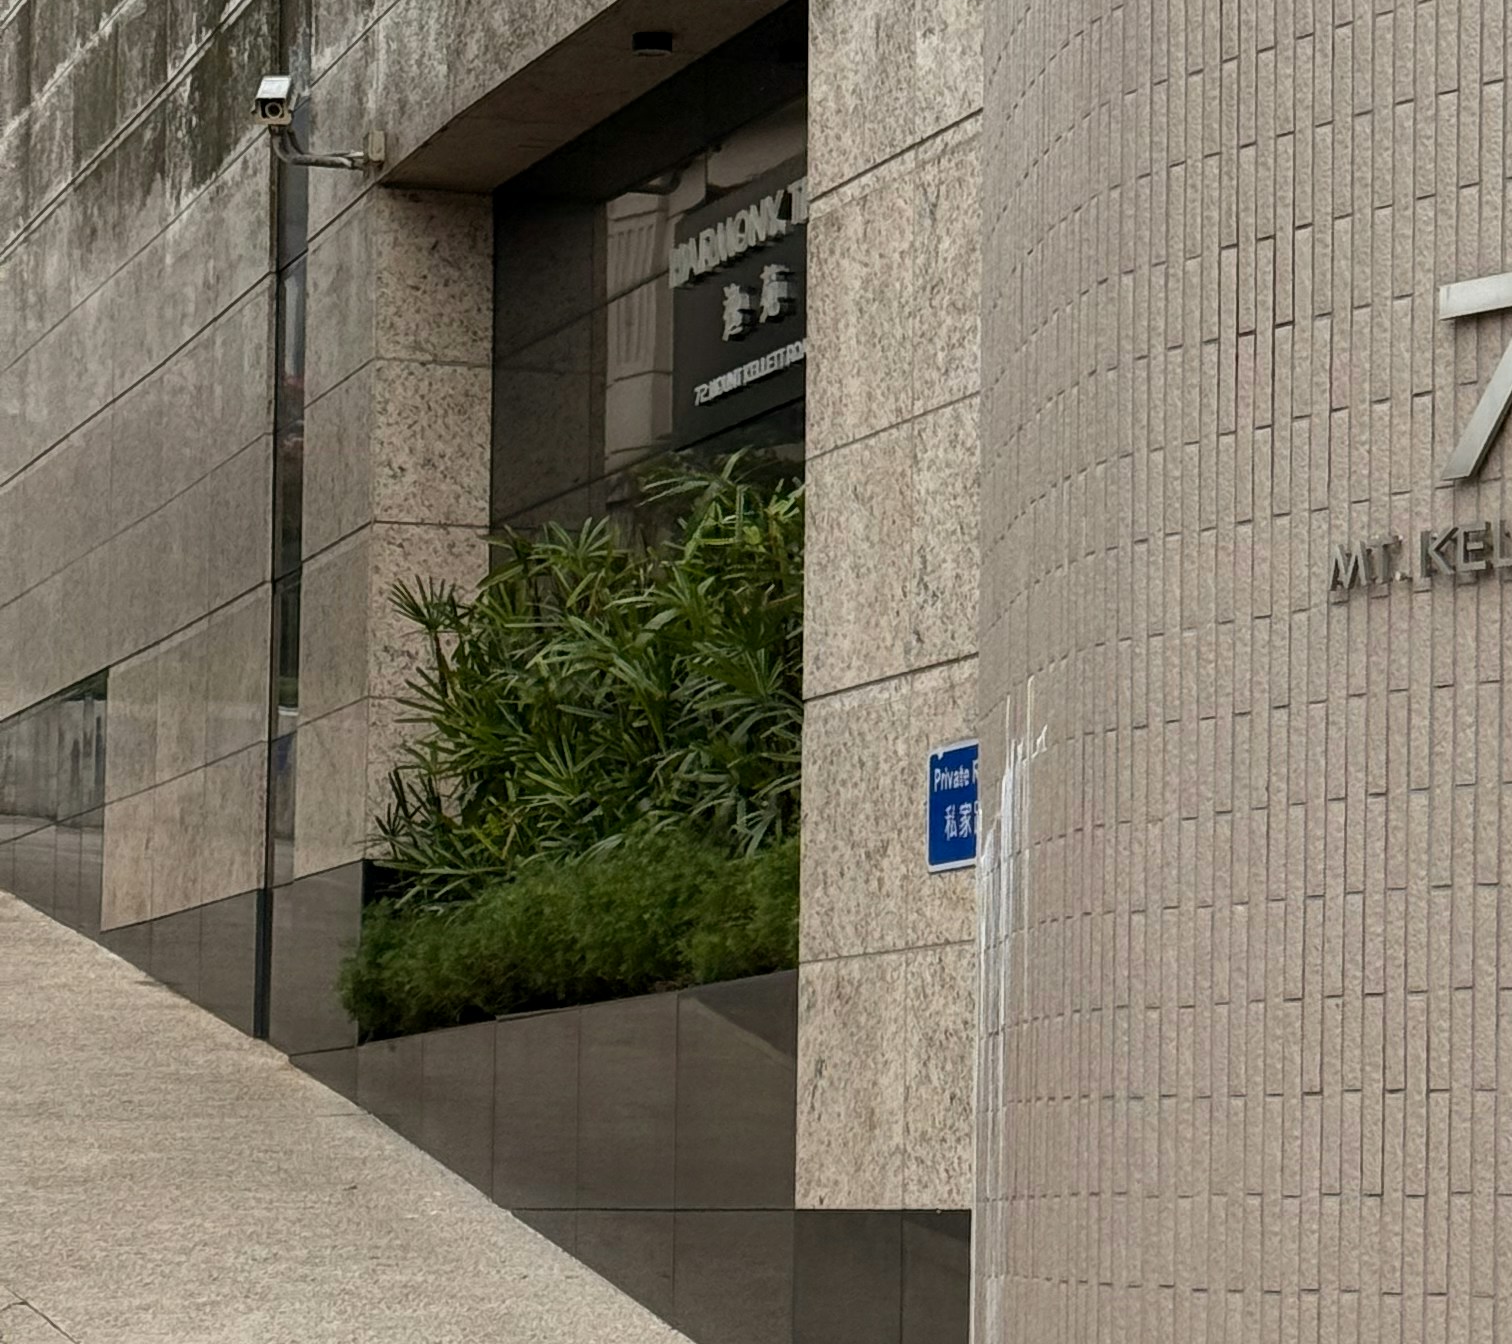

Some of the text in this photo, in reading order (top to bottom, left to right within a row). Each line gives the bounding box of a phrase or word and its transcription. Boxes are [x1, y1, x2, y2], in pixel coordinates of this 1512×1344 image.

[693, 383, 710, 407] 72
[742, 347, 788, 386] KELLETT
[933, 764, 970, 793] Private
